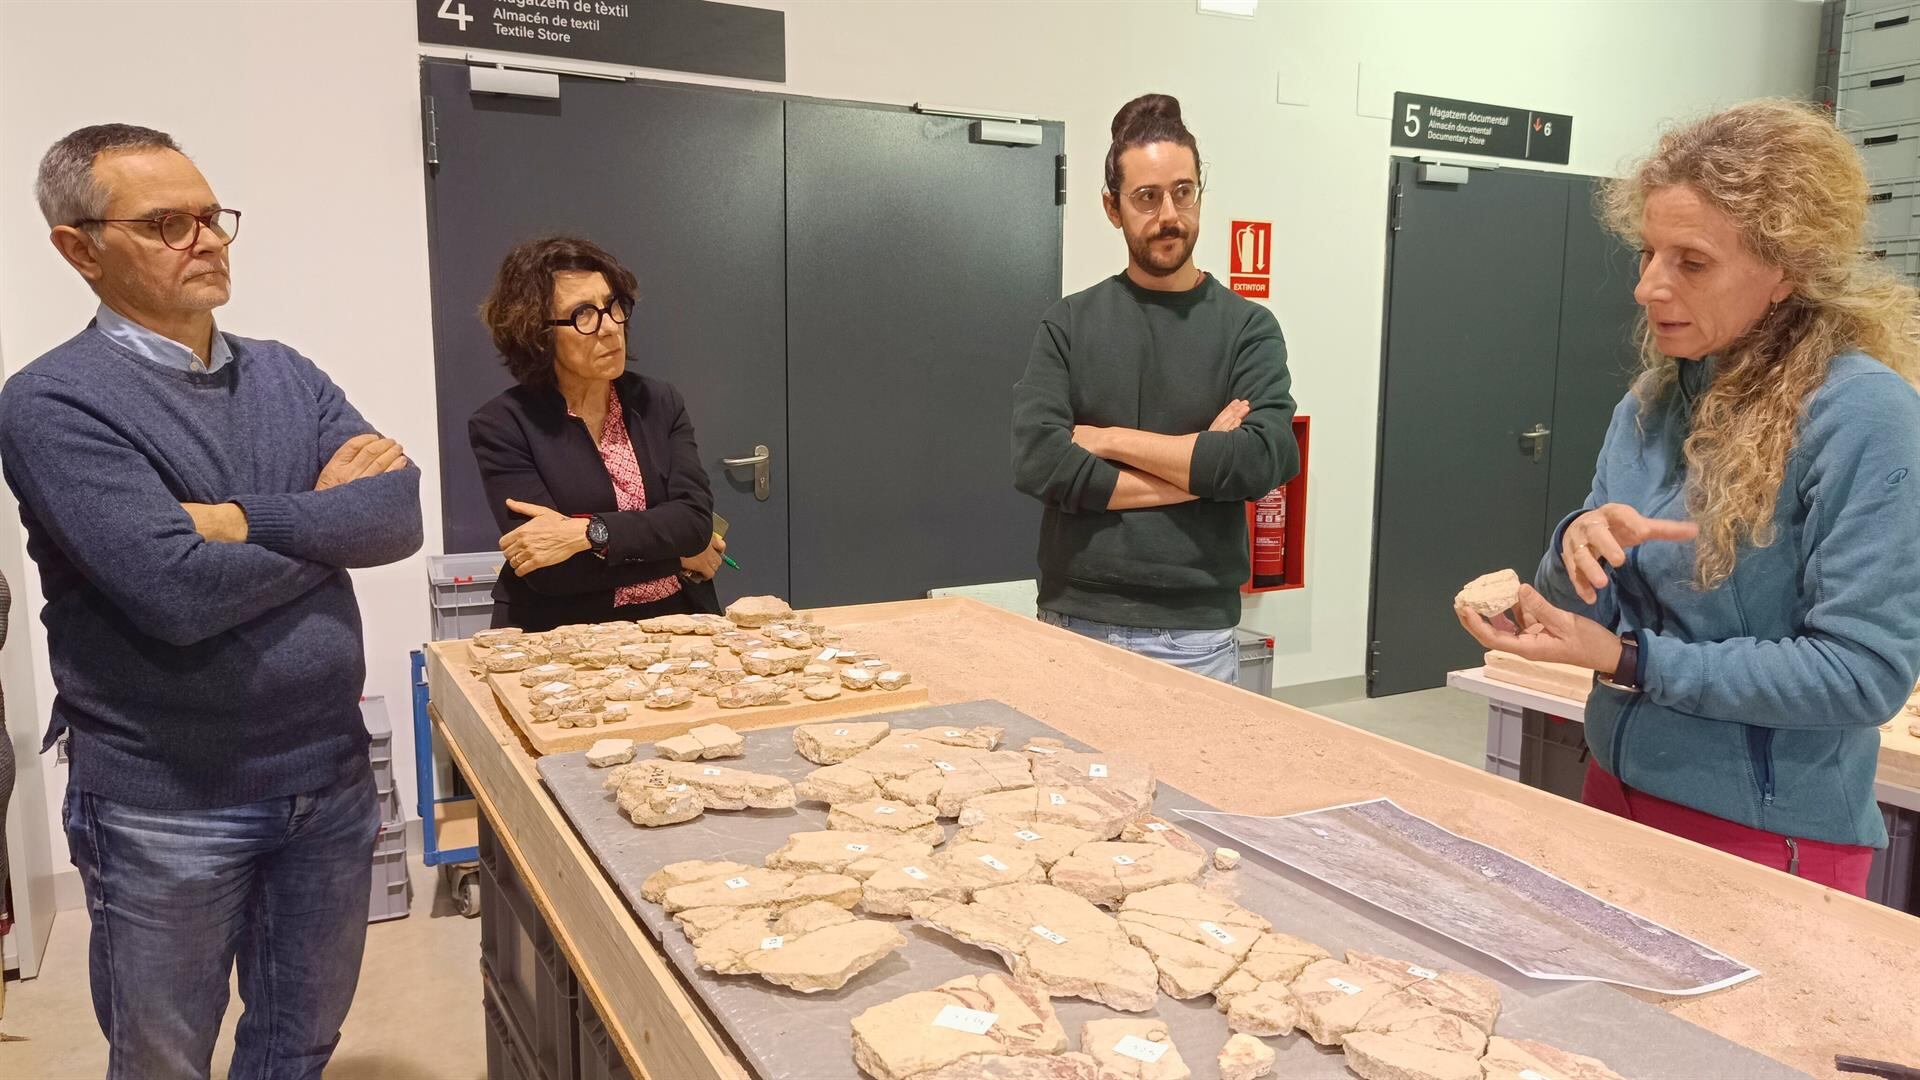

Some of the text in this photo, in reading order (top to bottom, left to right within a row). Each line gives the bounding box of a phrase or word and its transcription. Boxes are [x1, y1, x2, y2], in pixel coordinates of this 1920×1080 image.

[437, 0, 474, 31] 4
[573, 0, 592, 13] de
[594, 1, 629, 18] tèxtil
[493, 7, 600, 31] Almacén de textil
[493, 22, 571, 43] Textile Store
[1403, 103, 1421, 138] 5
[1429, 106, 1509, 126] Magatzem documental
[1428, 119, 1492, 136] Almacén documental
[1543, 122, 1553, 137] 6
[1427, 130, 1486, 146] Documentary Store
[1233, 283, 1266, 292] EXTINTOR
